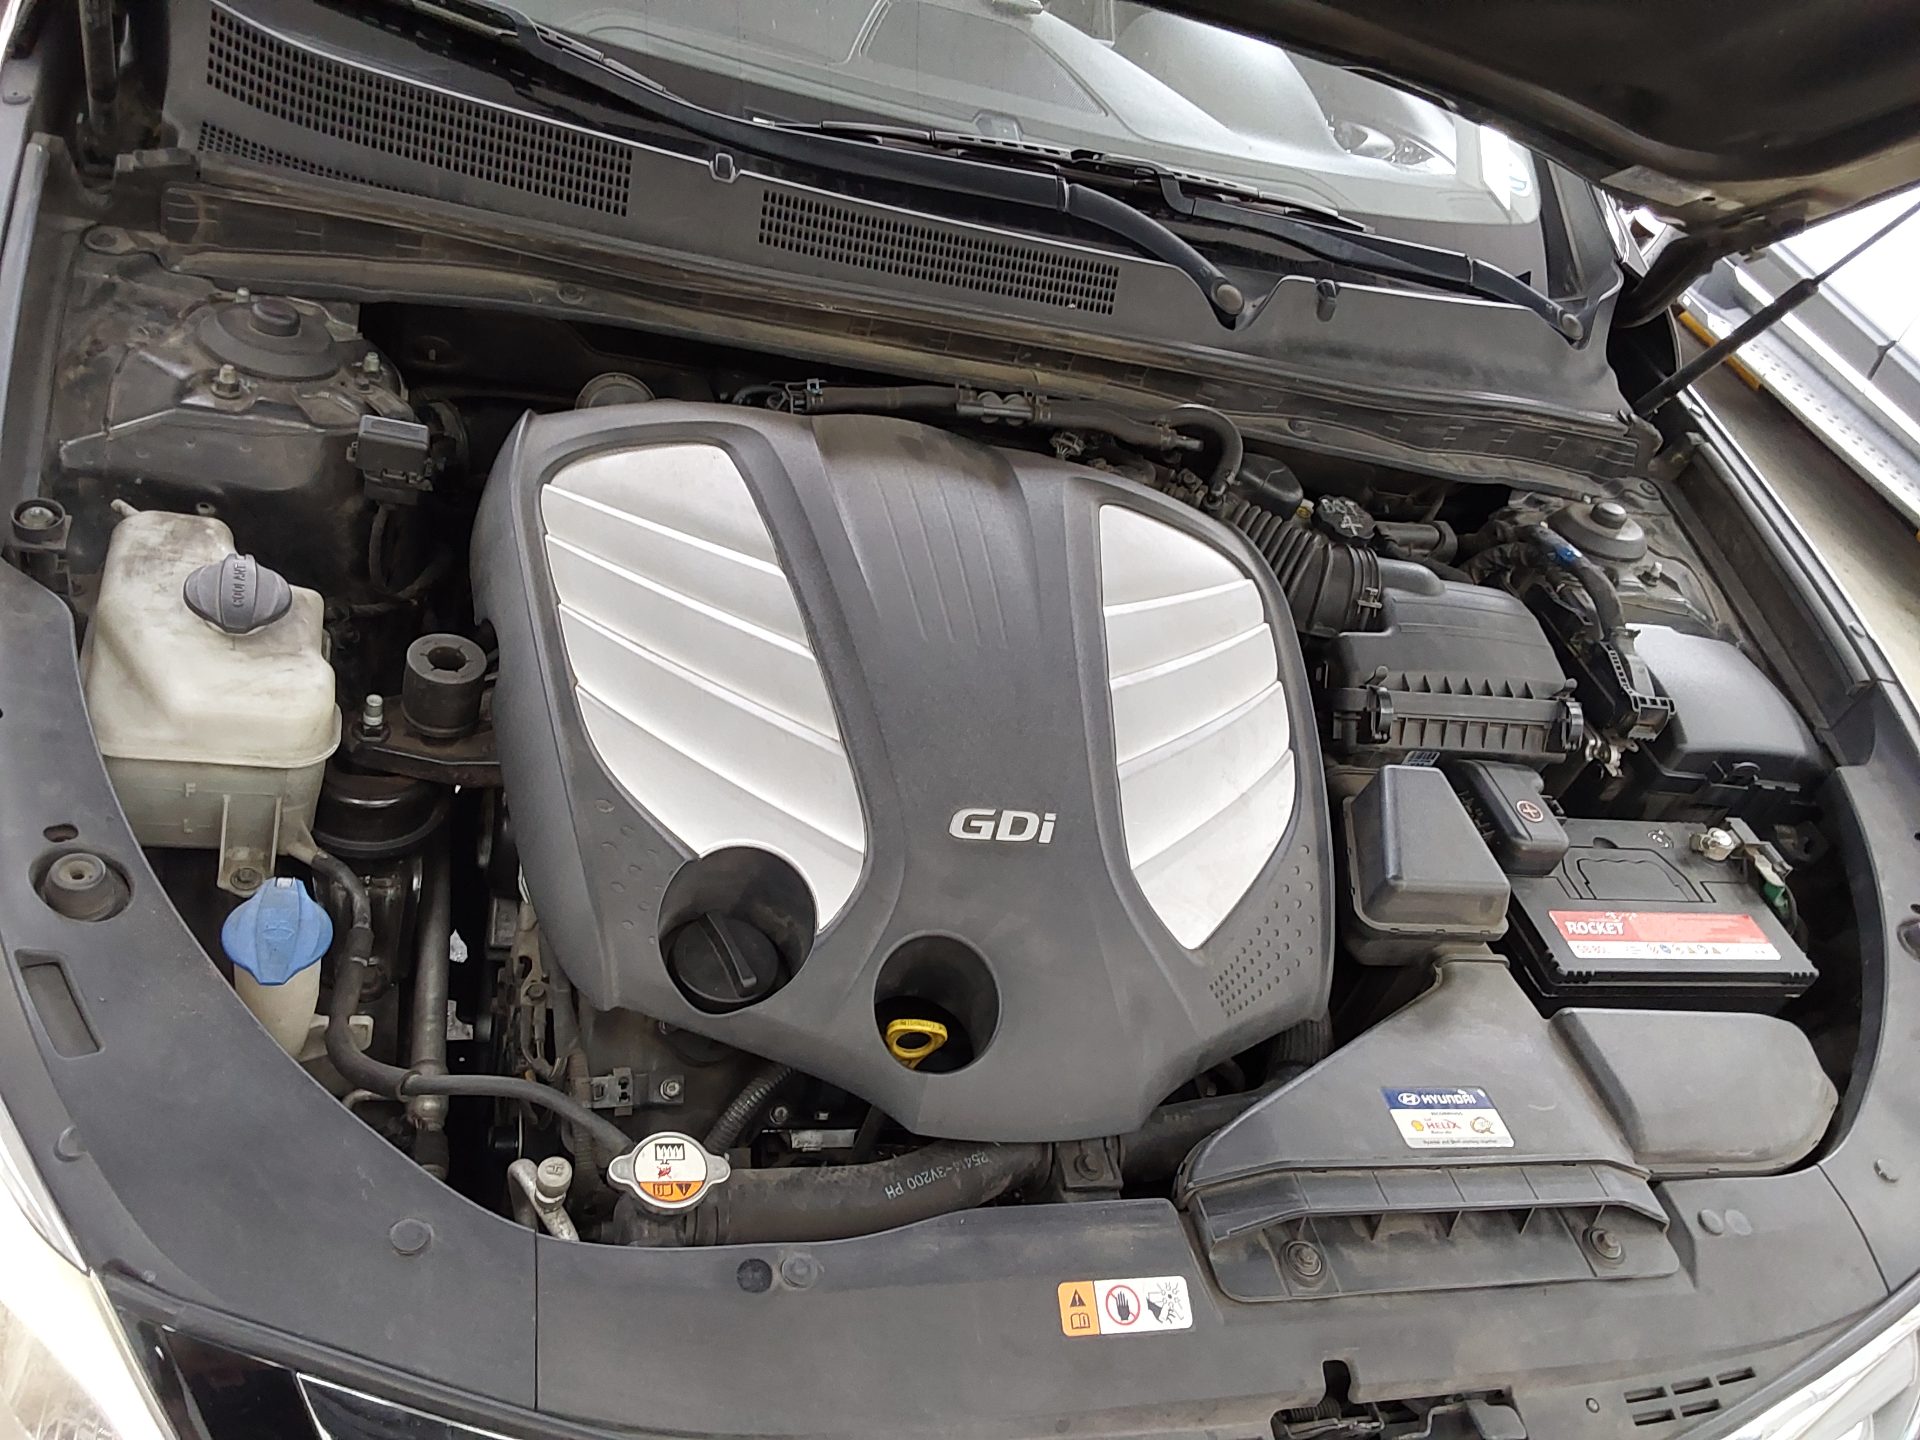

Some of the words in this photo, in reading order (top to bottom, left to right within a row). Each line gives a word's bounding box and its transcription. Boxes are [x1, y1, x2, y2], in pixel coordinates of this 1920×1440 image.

[1321, 498, 1358, 516] DOT
[1340, 514, 1364, 537] 4
[948, 807, 1058, 845] GDi
[1564, 921, 1625, 936] ROCKET
[1420, 1092, 1478, 1106] HYUNDAI
[1426, 1119, 1462, 1130] HELIX
[884, 1181, 905, 1200] PH
